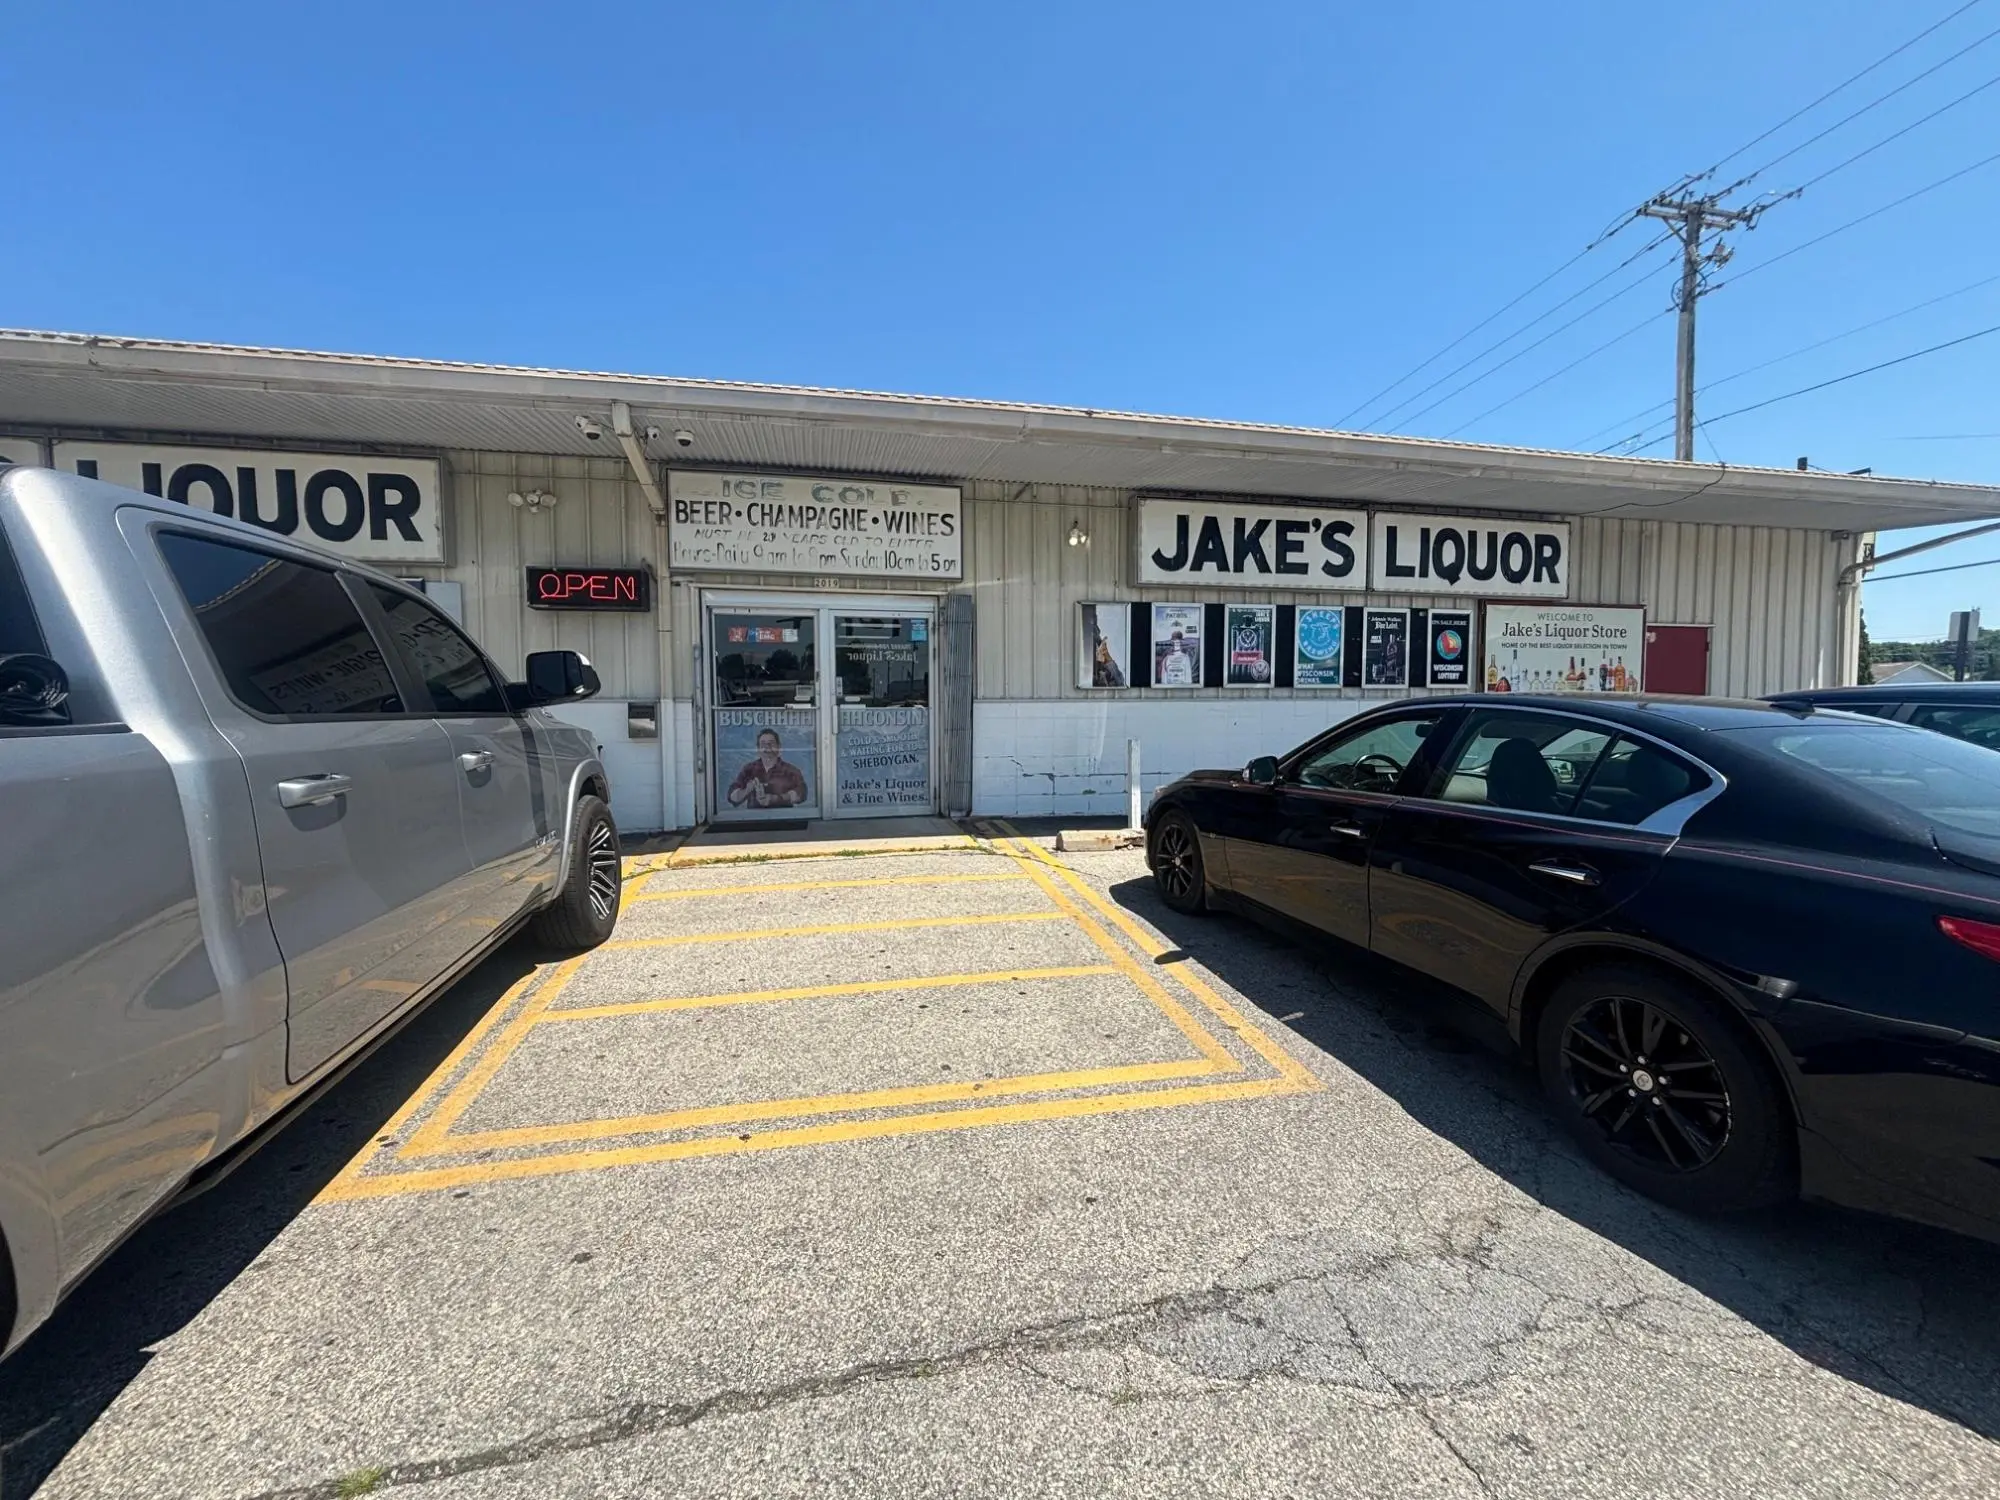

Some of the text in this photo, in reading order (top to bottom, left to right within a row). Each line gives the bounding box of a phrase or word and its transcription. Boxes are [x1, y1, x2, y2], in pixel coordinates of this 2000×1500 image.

[675, 500, 954, 536] BEER CHAMPAGNE WINES
[1151, 514, 1561, 586] JAKE'S LIQUOR
[540, 573, 635, 600] OPEN
[1538, 613, 1593, 622] WELCOME TO
[1502, 622, 1627, 640] Jake's Liquor Store
[853, 754, 919, 769] SHEBOYGAN.
[842, 779, 927, 791] Jake's Liquor
[842, 793, 852, 804] &
[857, 793, 883, 803] Fine
